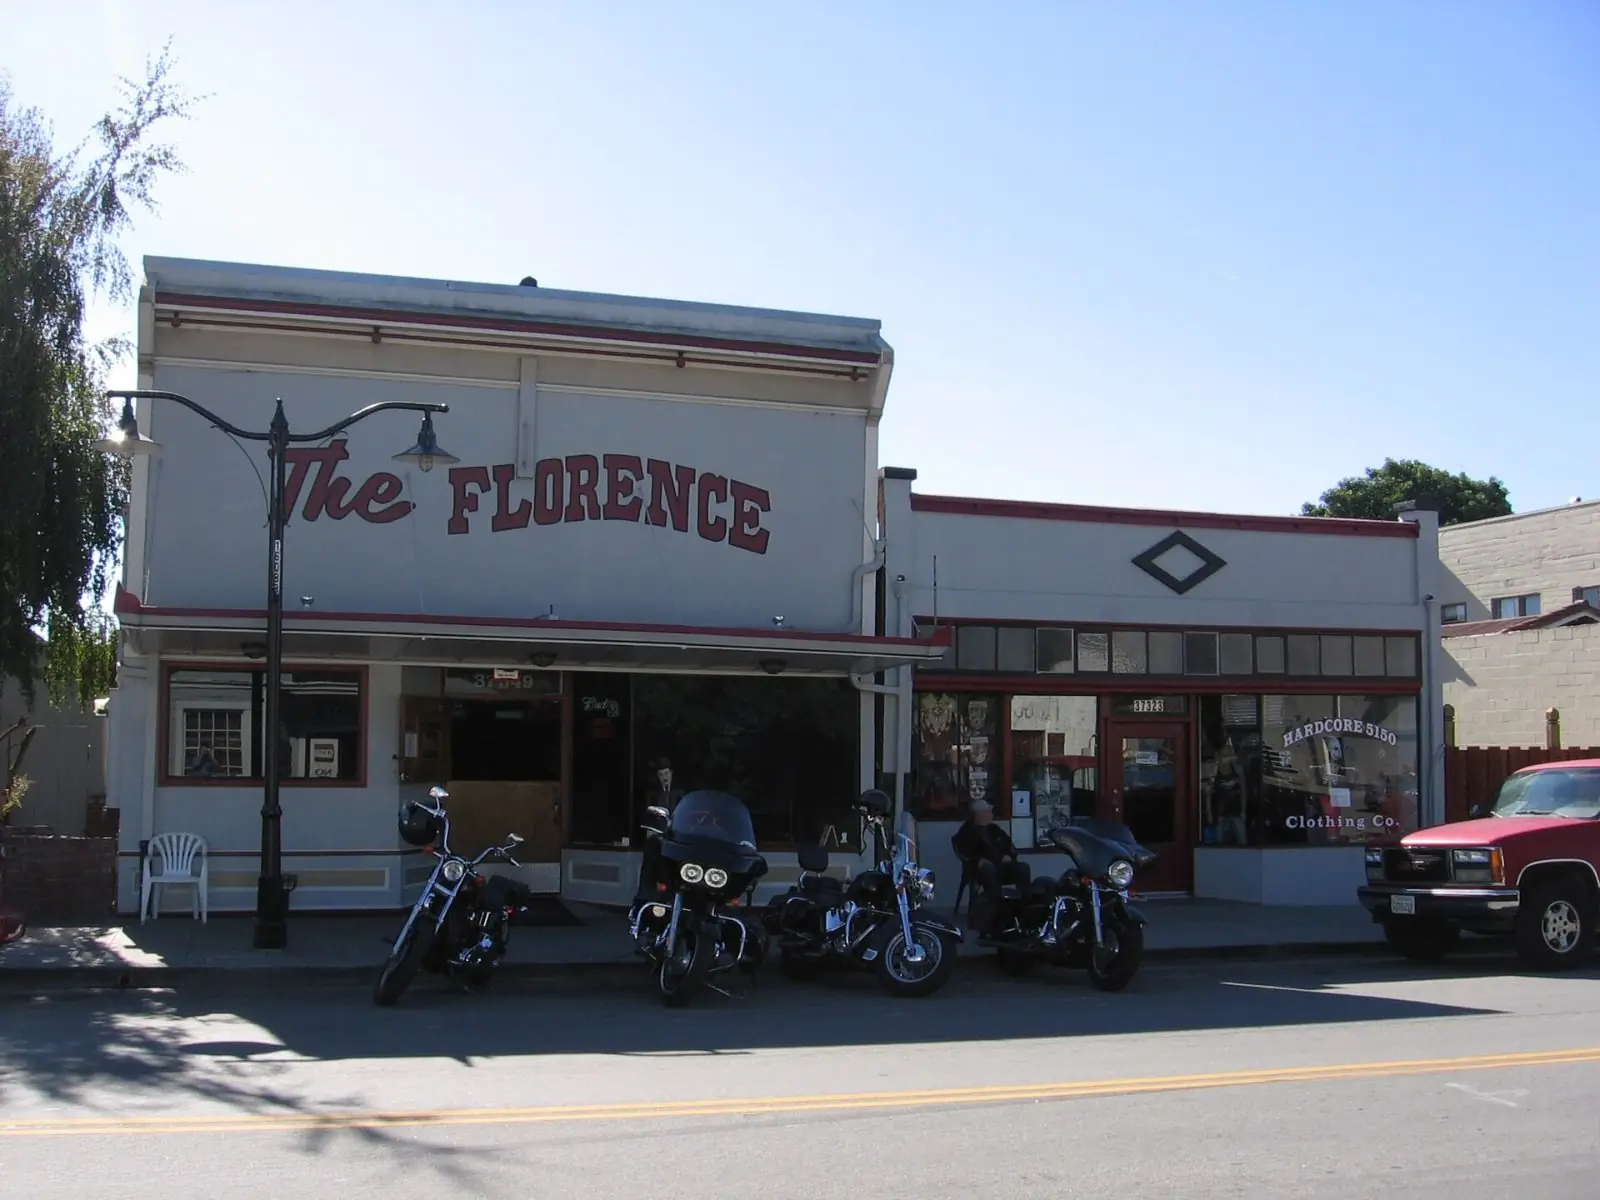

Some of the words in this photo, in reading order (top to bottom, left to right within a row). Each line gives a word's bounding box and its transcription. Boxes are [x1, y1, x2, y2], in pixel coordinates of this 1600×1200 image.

[284, 438, 416, 523] The
[448, 454, 771, 555] FLORENCE
[1133, 699, 1164, 712] 37323
[1283, 718, 1363, 748] HARDCORE
[1366, 723, 1397, 746] 5150
[1285, 815, 1365, 830] Clothing
[1372, 815, 1400, 827] Co.
